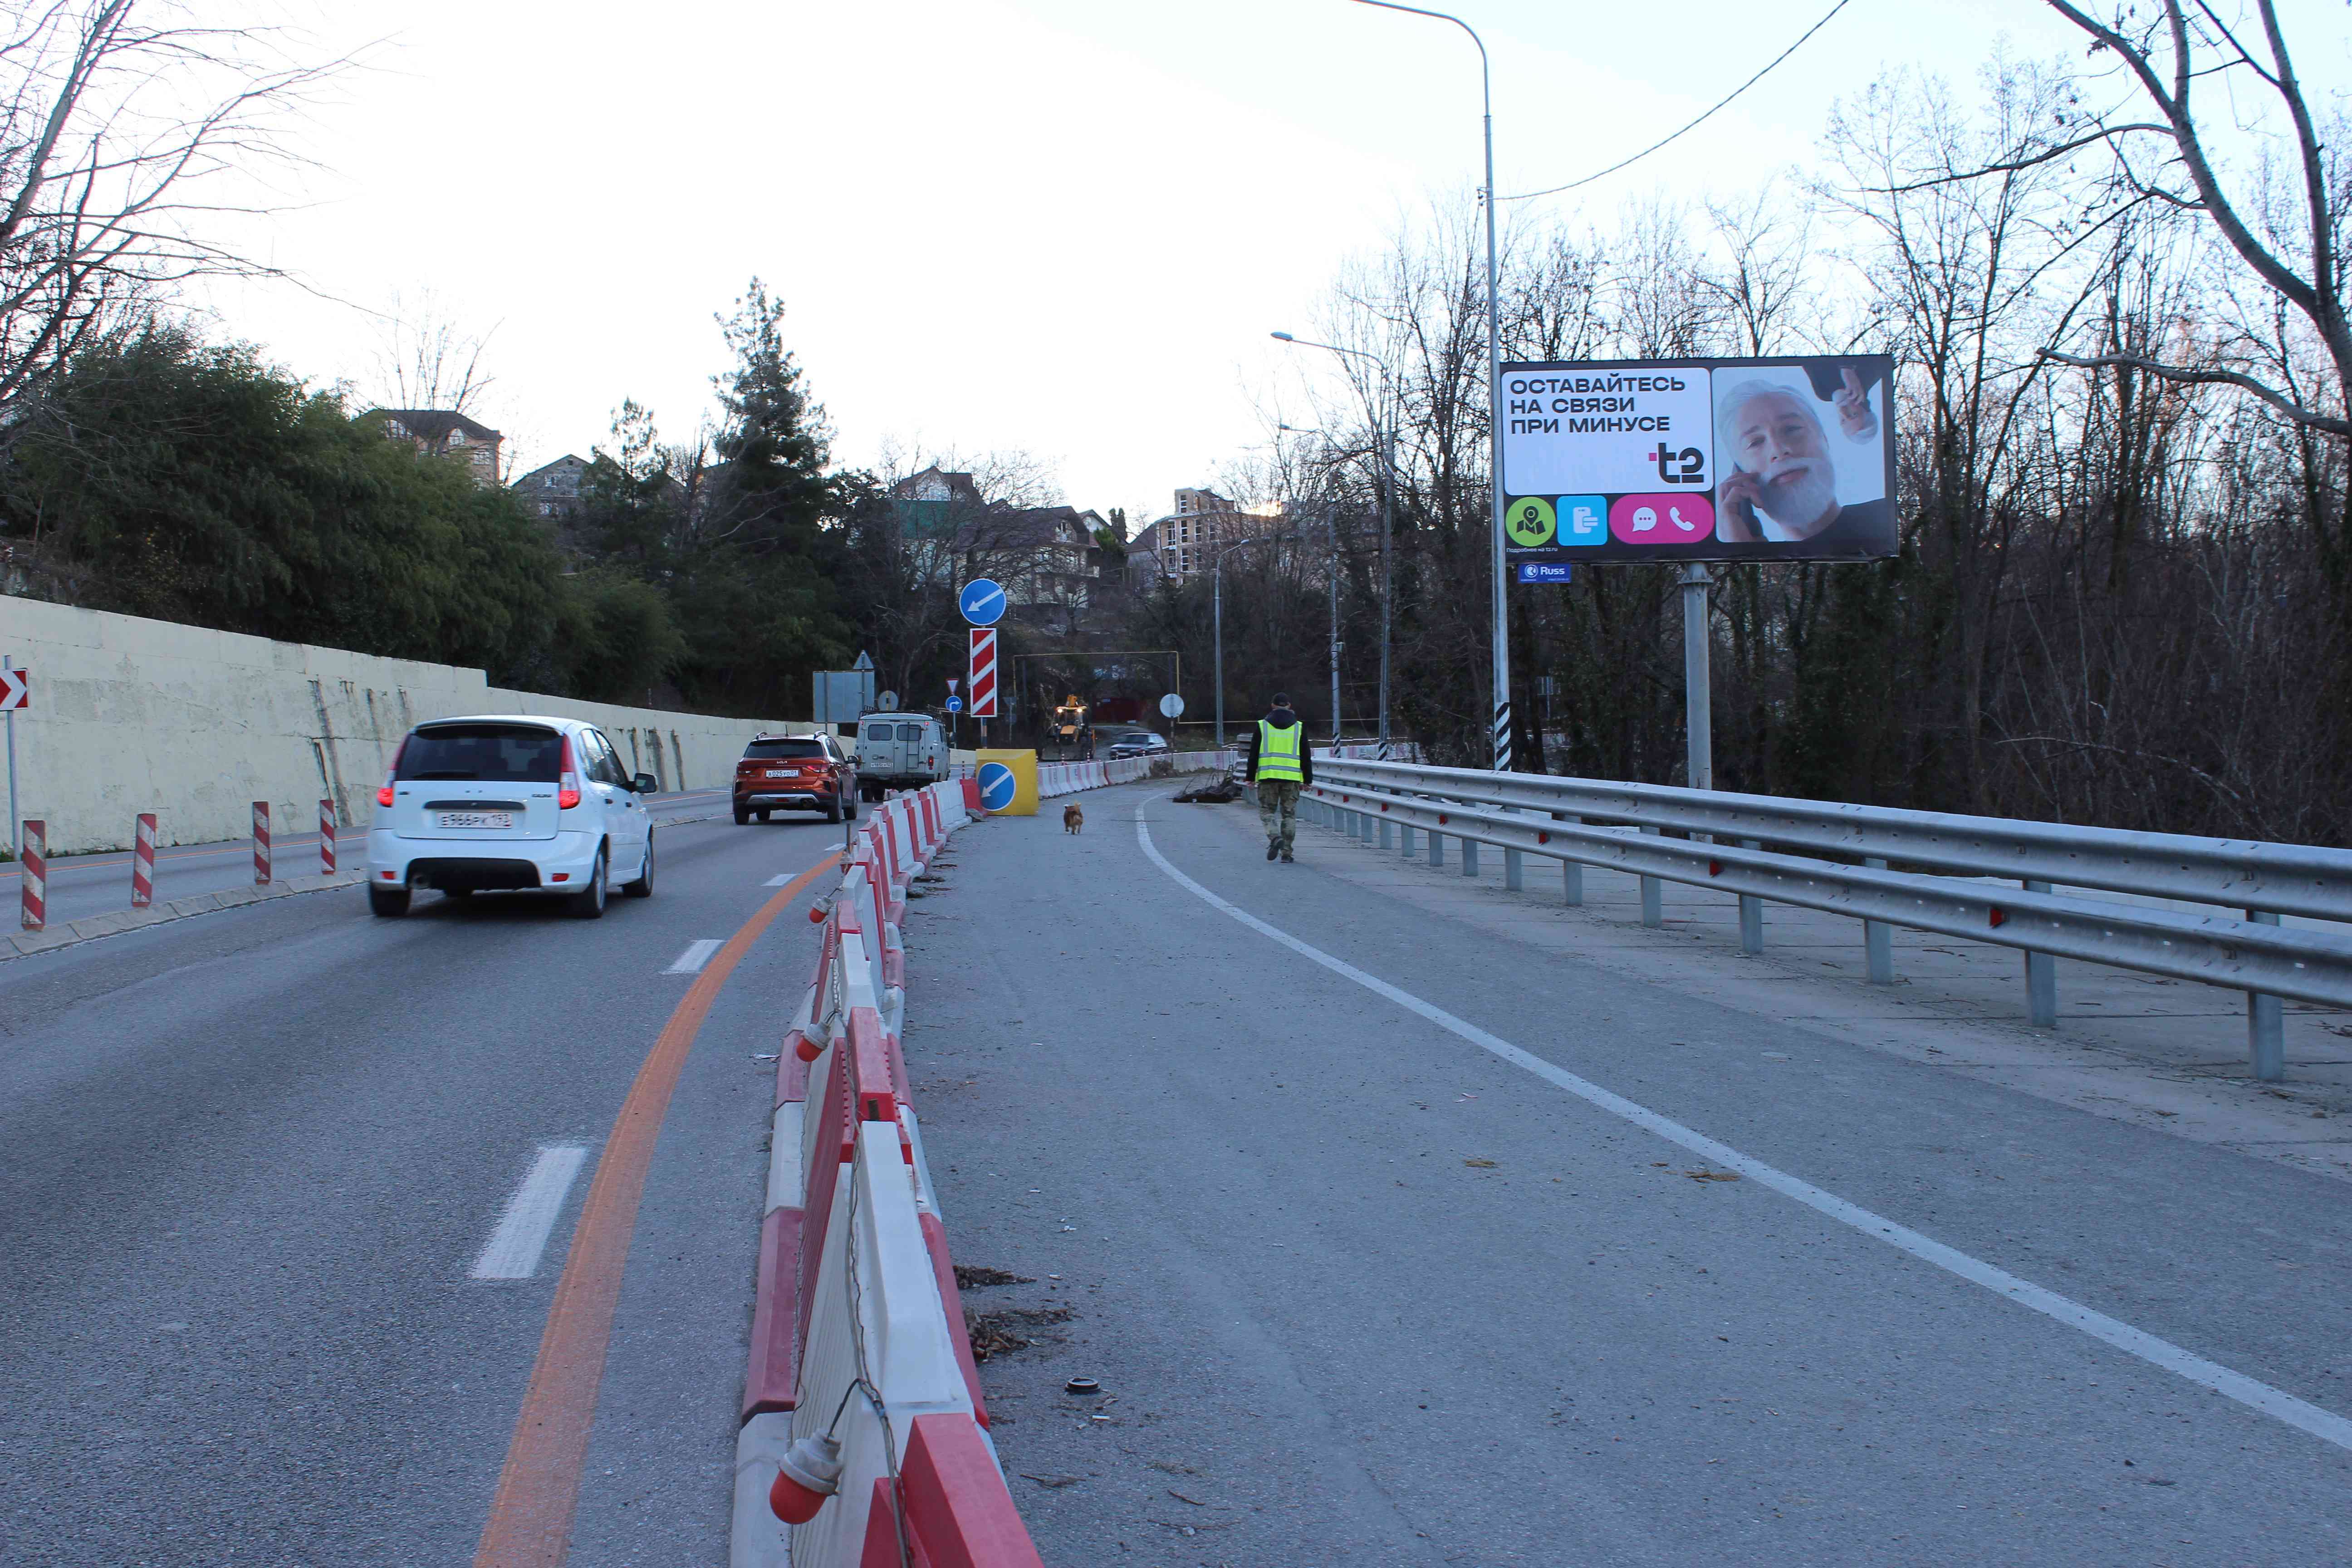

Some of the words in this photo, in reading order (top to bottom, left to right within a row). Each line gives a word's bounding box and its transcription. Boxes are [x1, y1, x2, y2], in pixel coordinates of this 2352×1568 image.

[1510, 373, 1685, 394] ОСТАВАЙТЕСЬ
[1510, 399, 1543, 414] НА
[1552, 397, 1634, 413] СВЯЗИ
[1511, 418, 1559, 434] ПРИ
[1569, 416, 1670, 433] МИНУСЕ
[1649, 442, 1704, 483] t2
[1540, 567, 1565, 575] Russ
